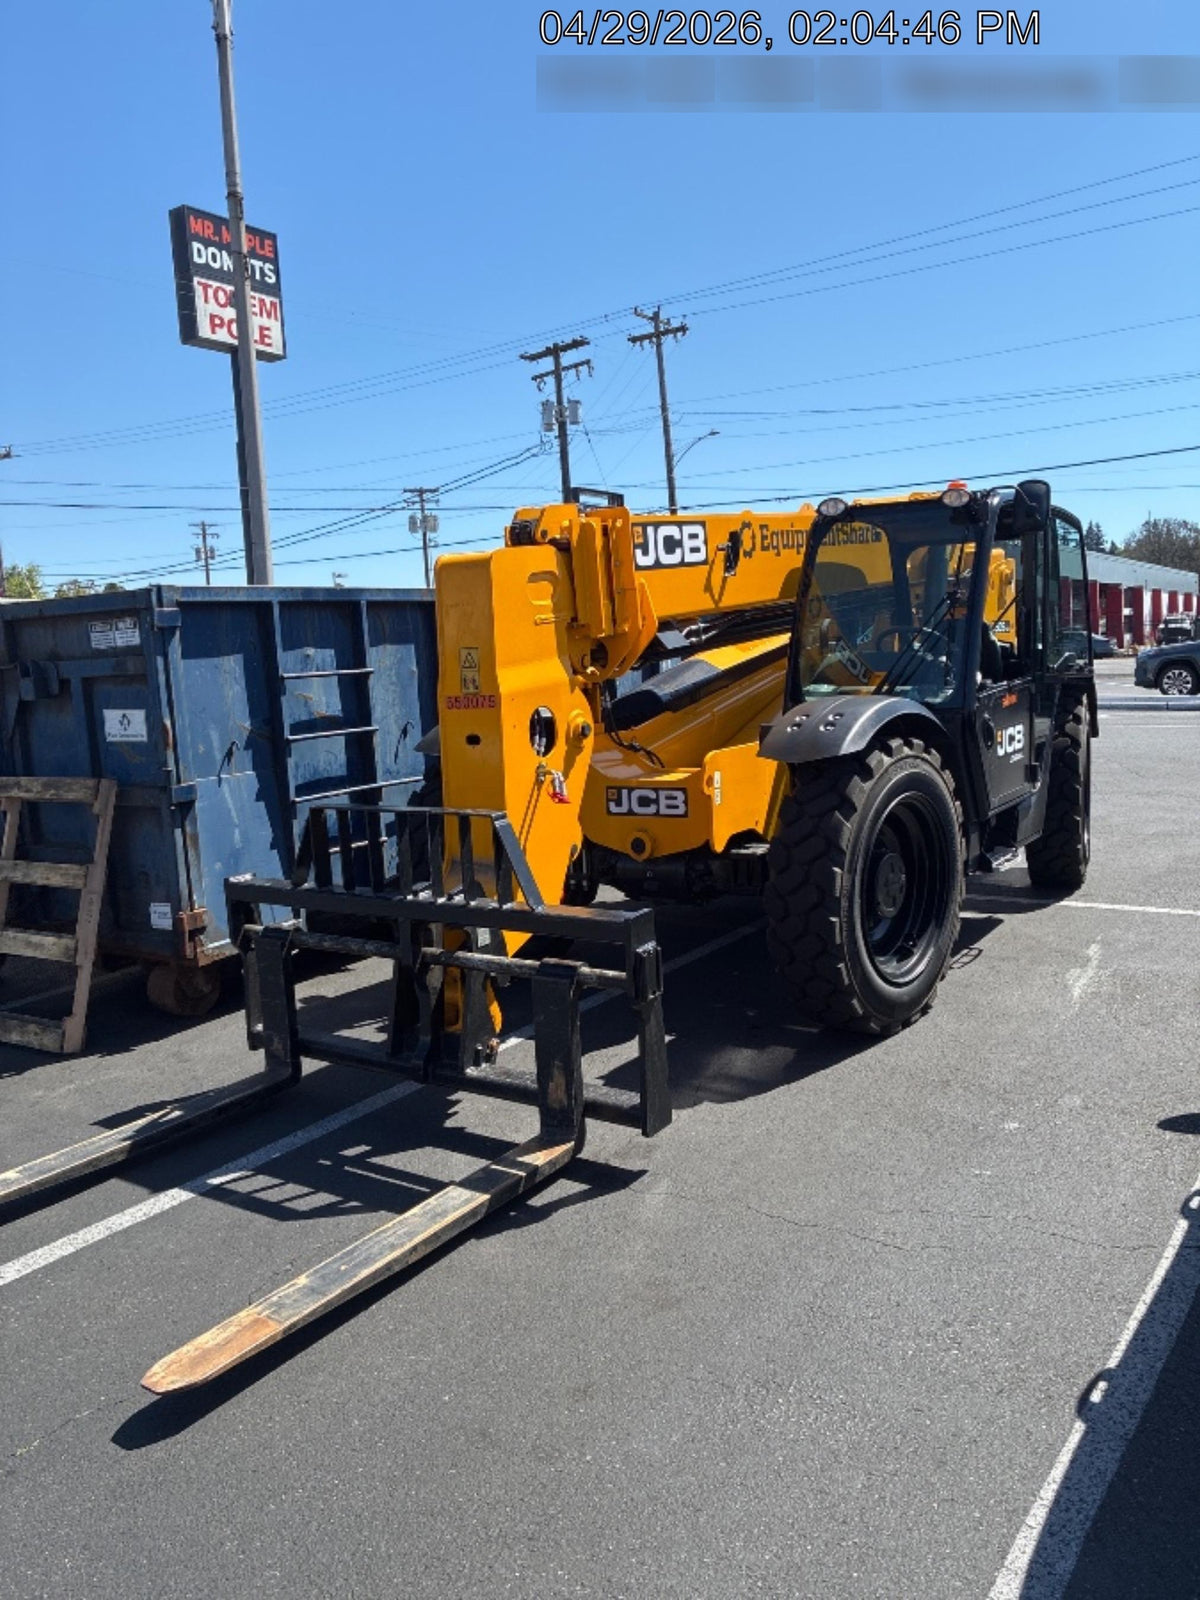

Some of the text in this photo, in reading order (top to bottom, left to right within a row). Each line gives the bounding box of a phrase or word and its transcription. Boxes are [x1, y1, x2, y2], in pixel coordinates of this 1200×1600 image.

[190, 215, 274, 257] MR. MPLE
[192, 241, 276, 284] DONTS
[209, 313, 273, 347] POE
[635, 524, 706, 566] JCB
[997, 724, 1024, 756] JCB
[609, 789, 686, 815] JCB
